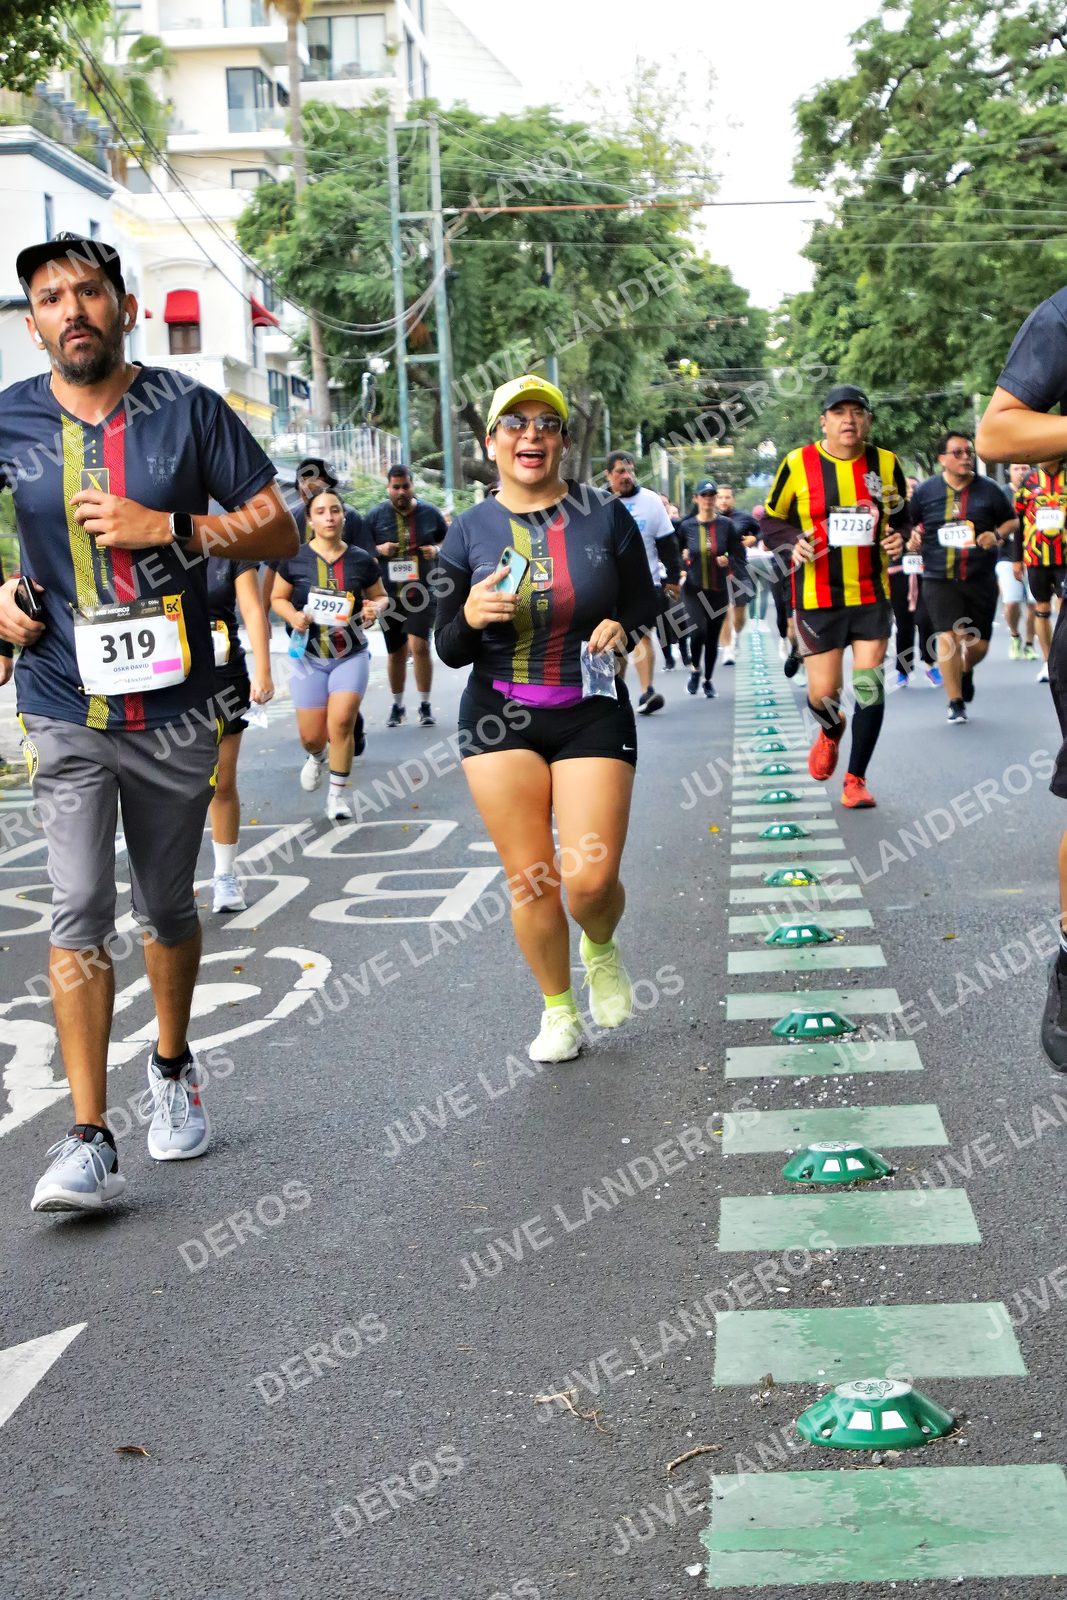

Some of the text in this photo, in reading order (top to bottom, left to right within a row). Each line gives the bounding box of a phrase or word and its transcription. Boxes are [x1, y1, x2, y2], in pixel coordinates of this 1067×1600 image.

[833, 519, 873, 532] 12736
[944, 528, 967, 540] 6715
[166, 603, 178, 613] 5K
[313, 598, 344, 614] 2997
[100, 629, 156, 663] 319
[130, 663, 149, 671] DAVID
